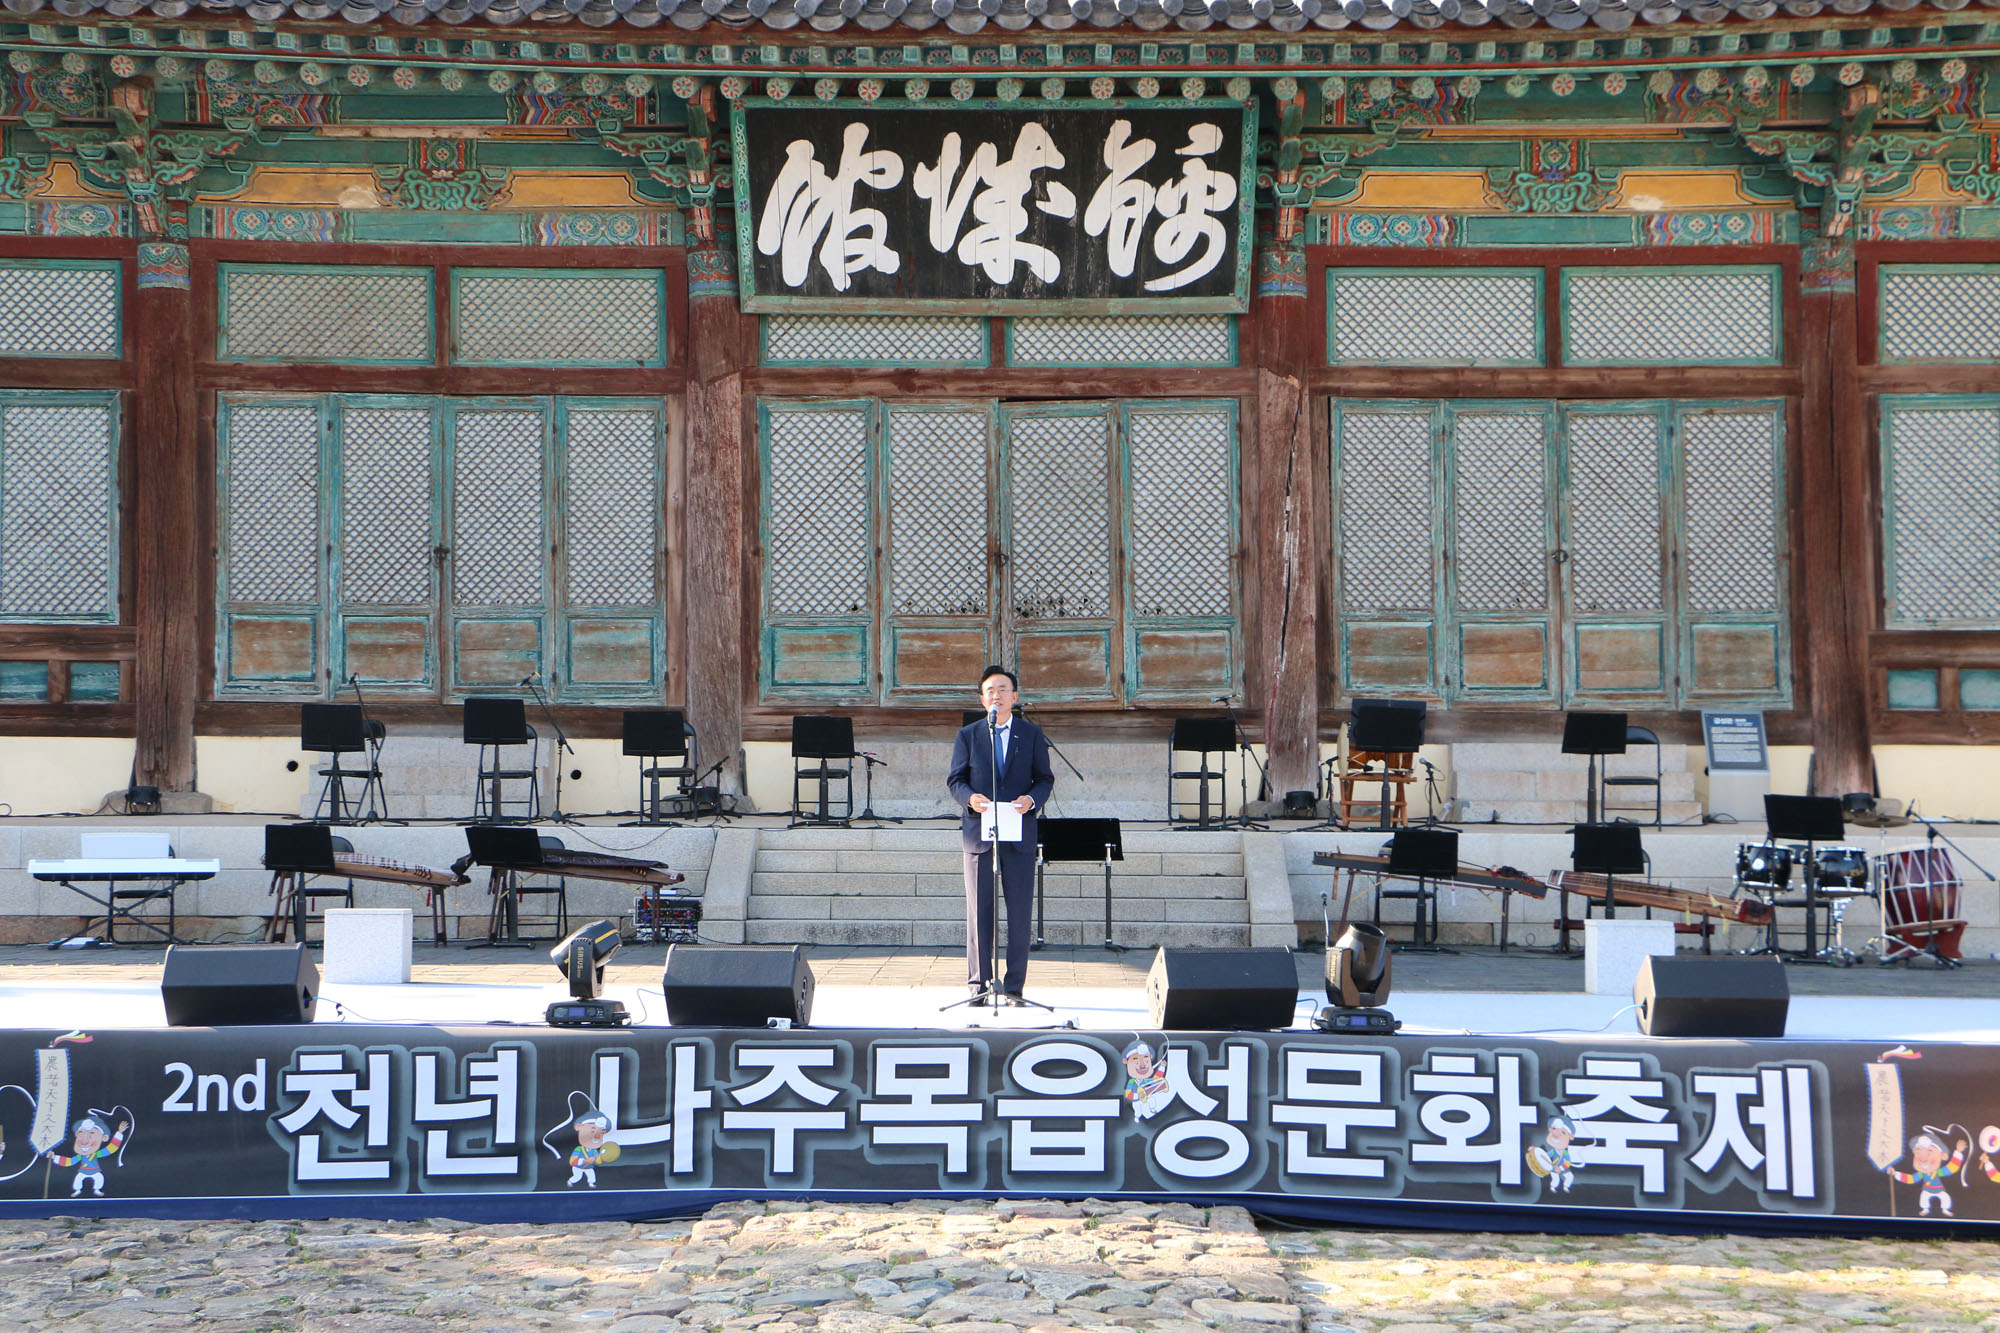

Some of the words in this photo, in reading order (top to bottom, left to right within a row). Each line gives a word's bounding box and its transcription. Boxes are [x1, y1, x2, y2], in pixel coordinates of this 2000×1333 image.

[162, 1058, 266, 1112] 2nd
[277, 1048, 519, 1180] 천년
[599, 1042, 1816, 1198] 나주목읍성문화축제
